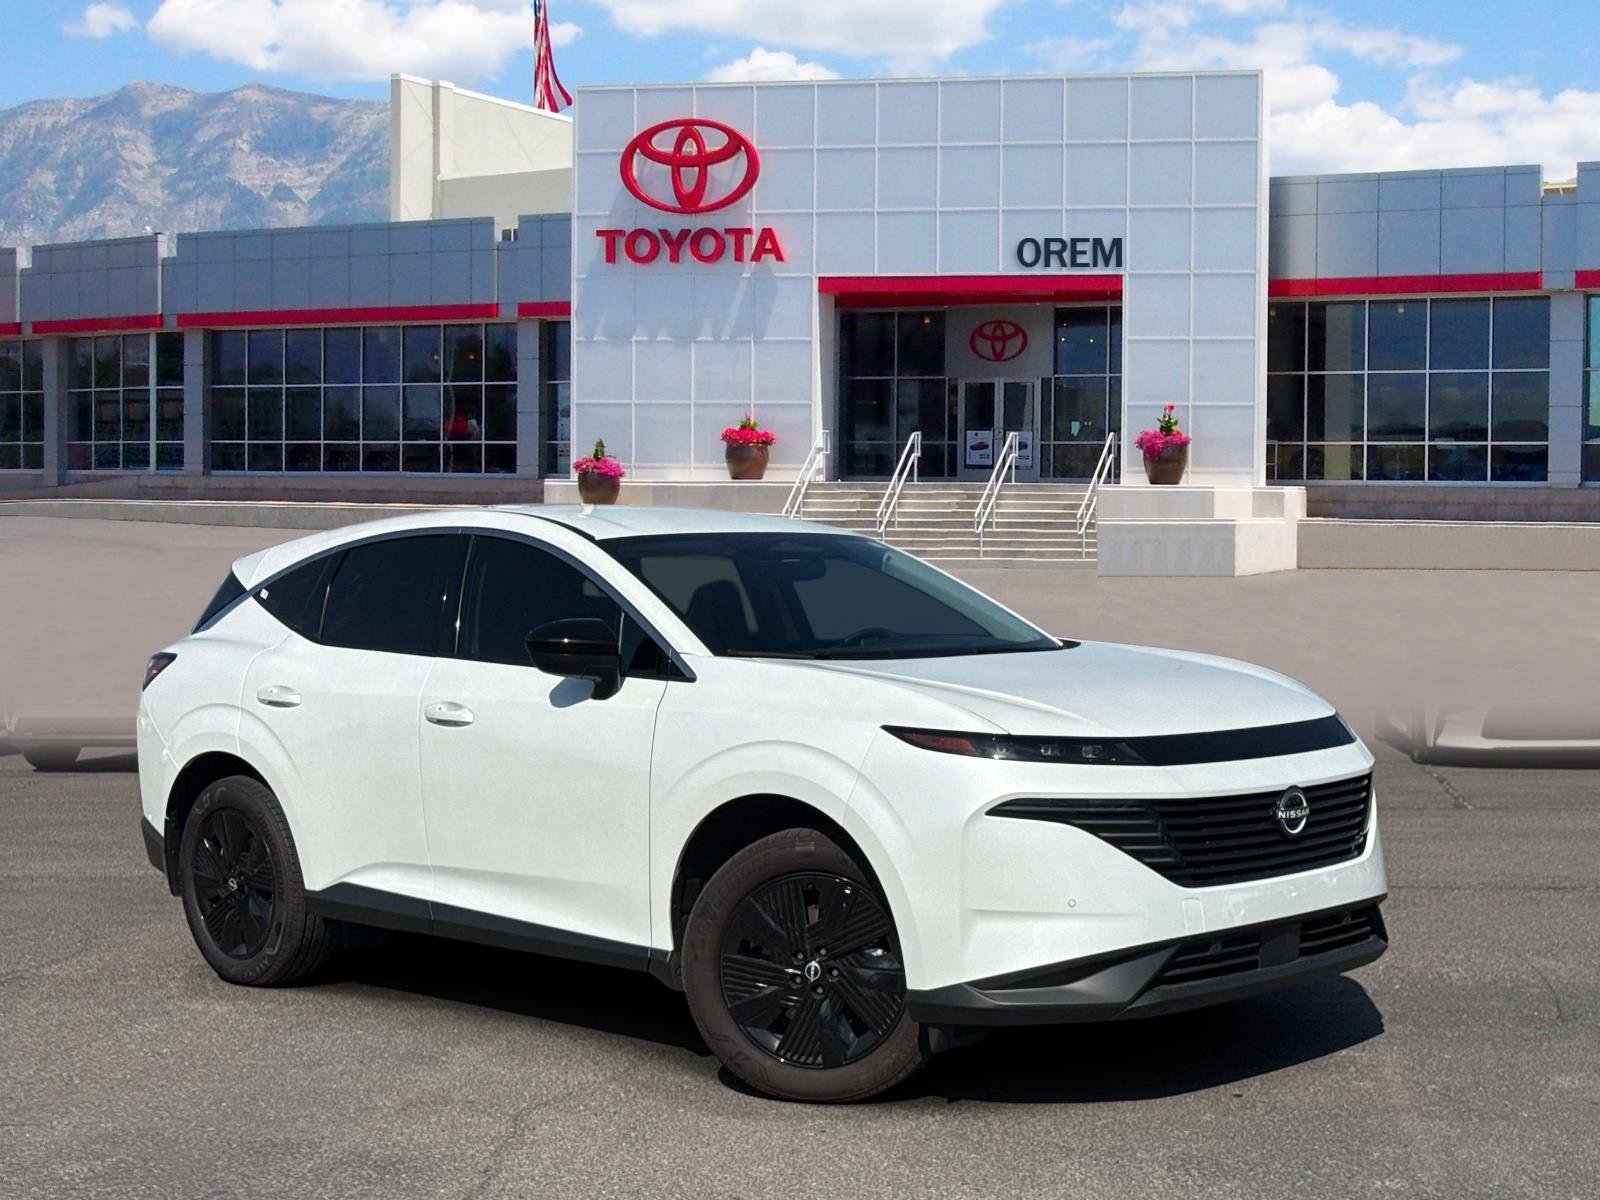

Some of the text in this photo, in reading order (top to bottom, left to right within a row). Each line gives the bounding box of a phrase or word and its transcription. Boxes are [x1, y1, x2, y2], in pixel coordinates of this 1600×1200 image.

[596, 227, 784, 264] TOYOTA
[1017, 237, 1123, 268] OREM
[1278, 807, 1310, 819] NISSAN
